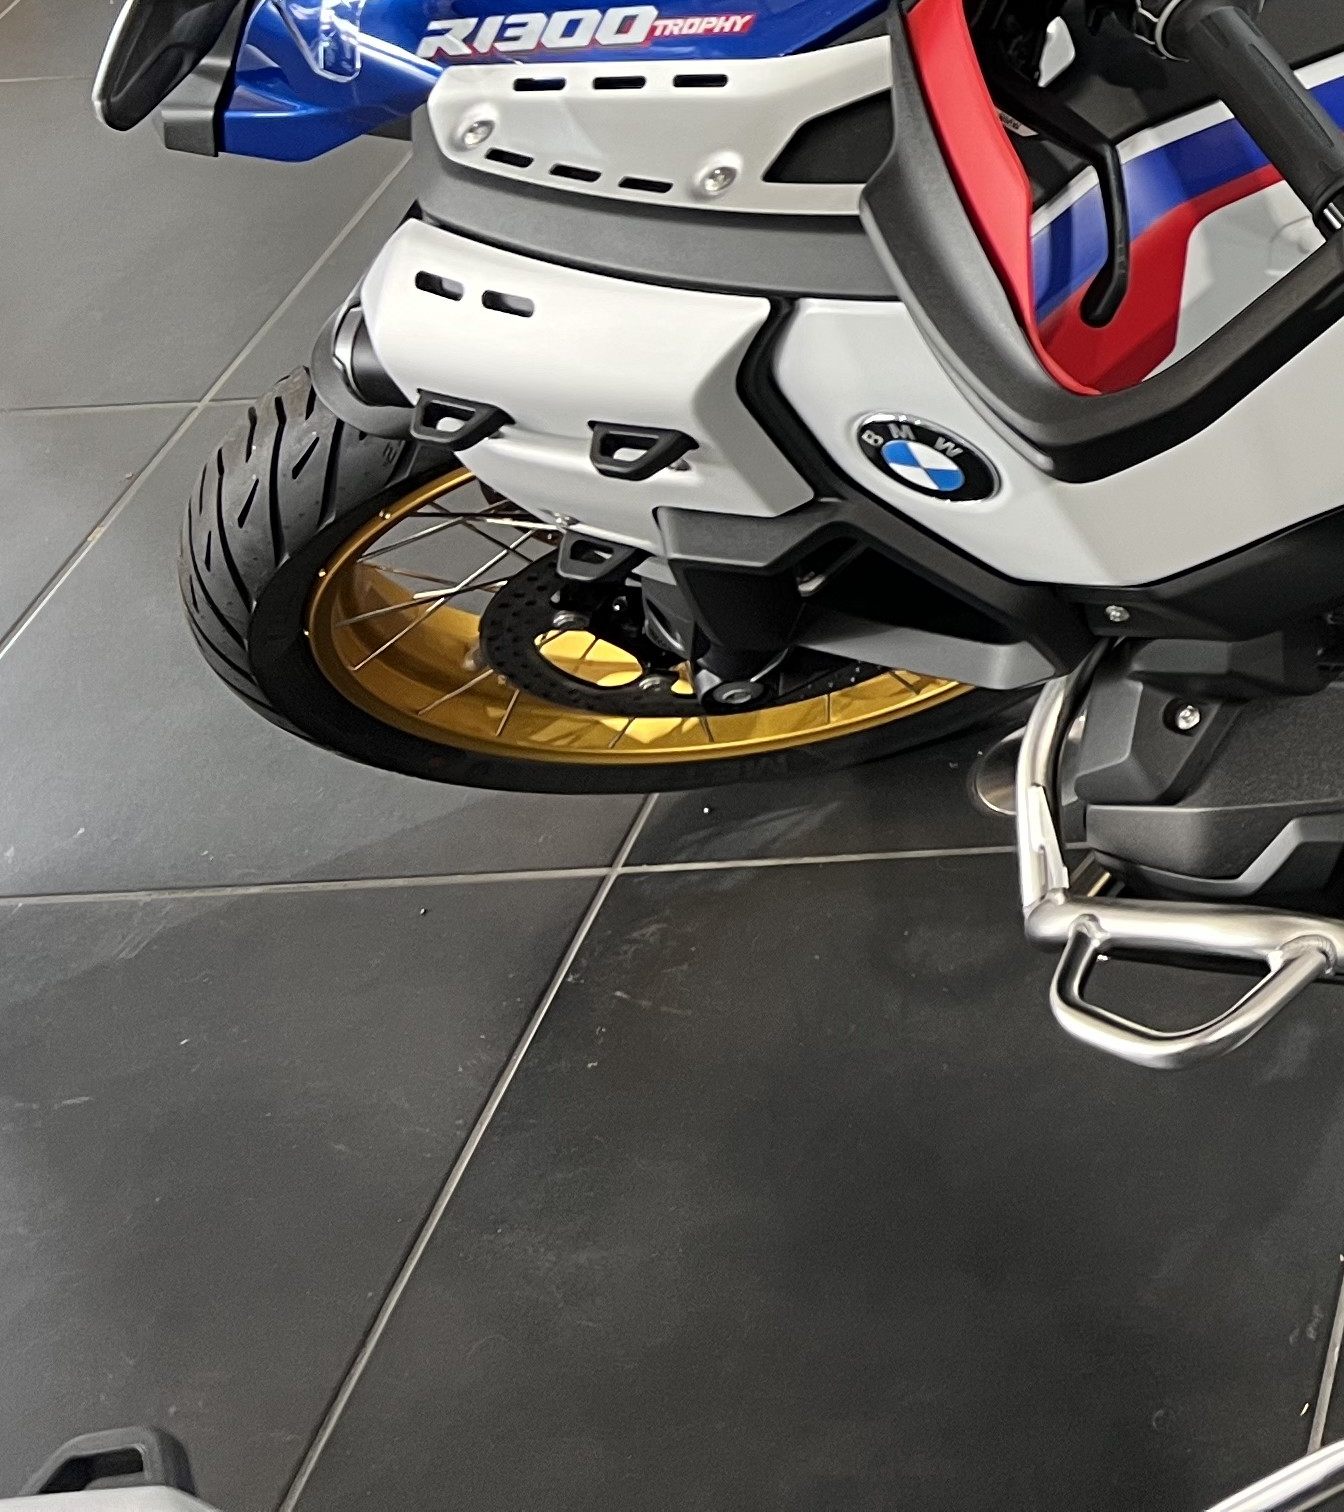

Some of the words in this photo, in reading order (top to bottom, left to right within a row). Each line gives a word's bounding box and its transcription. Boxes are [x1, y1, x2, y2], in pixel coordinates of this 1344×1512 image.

[415, 4, 659, 59] R1300
[652, 14, 753, 37] TROPHY
[860, 422, 964, 458] BMW
